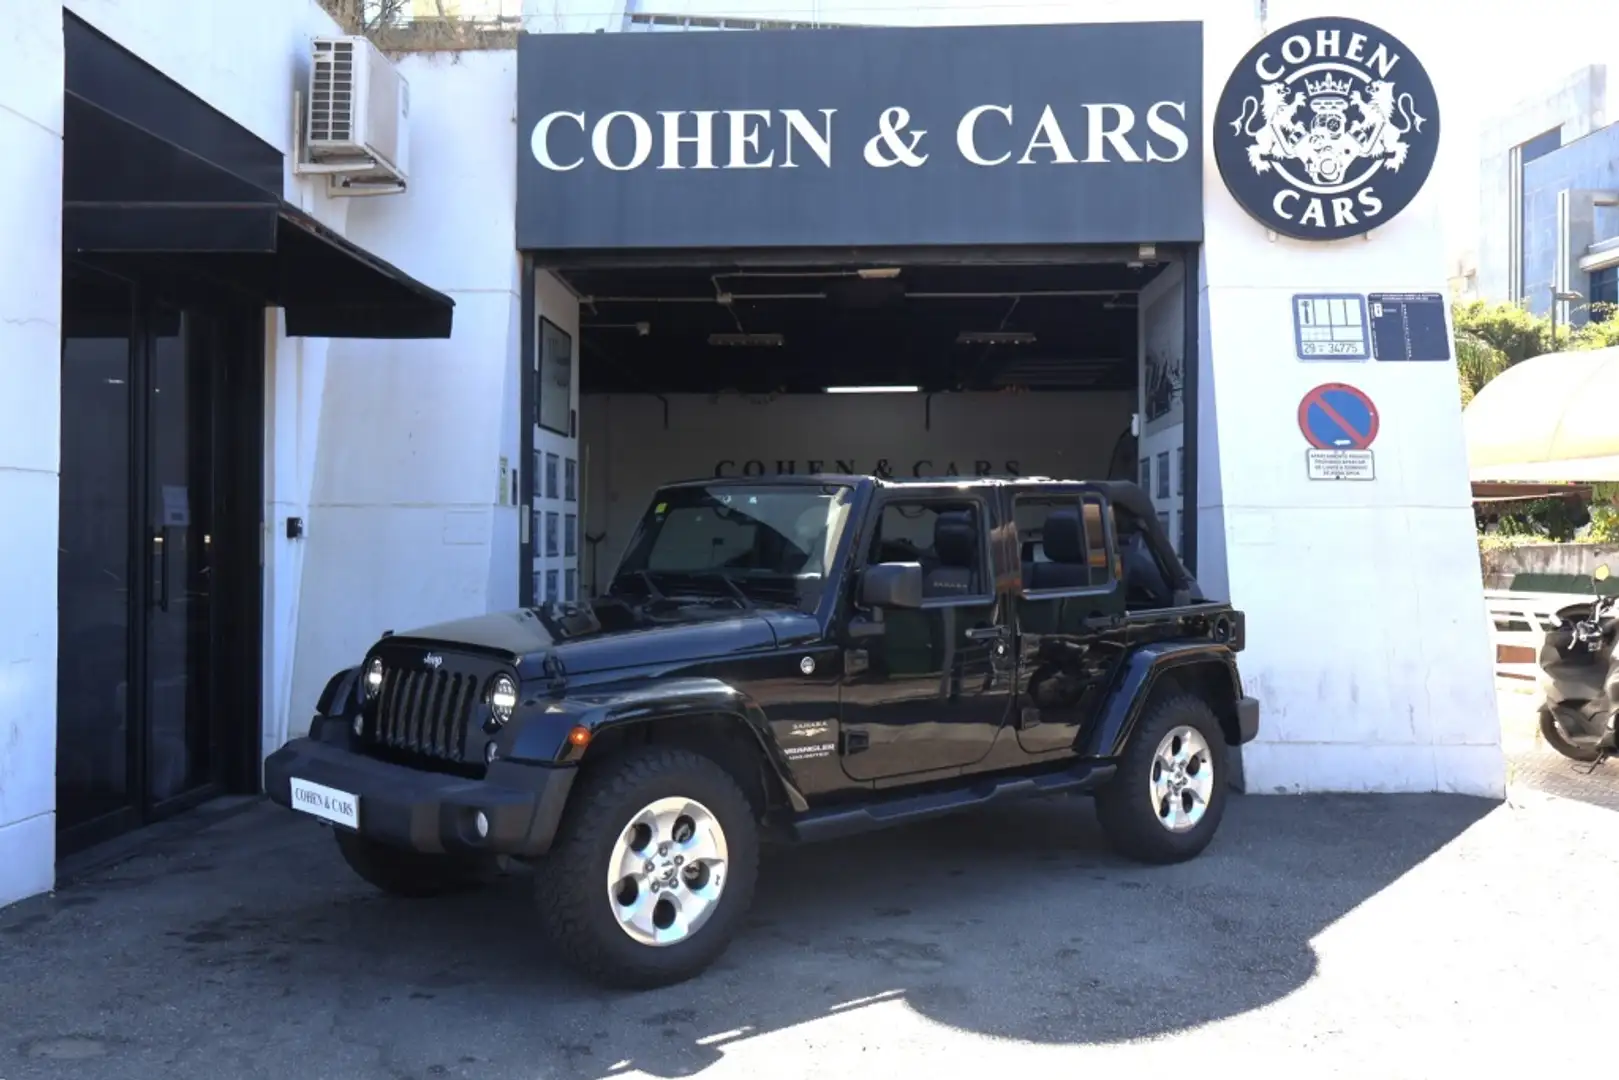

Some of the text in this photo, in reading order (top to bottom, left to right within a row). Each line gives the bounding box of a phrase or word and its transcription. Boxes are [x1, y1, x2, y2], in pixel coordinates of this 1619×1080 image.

[1256, 30, 1400, 82] COHEN
[530, 100, 1190, 172] COHEN & CARS
[1273, 186, 1383, 228] CARS
[714, 458, 1020, 478] COHEN & CARS
[423, 651, 443, 668] Jeep
[783, 743, 835, 755] WRANGLER
[295, 787, 354, 817] COHEN & CARS
